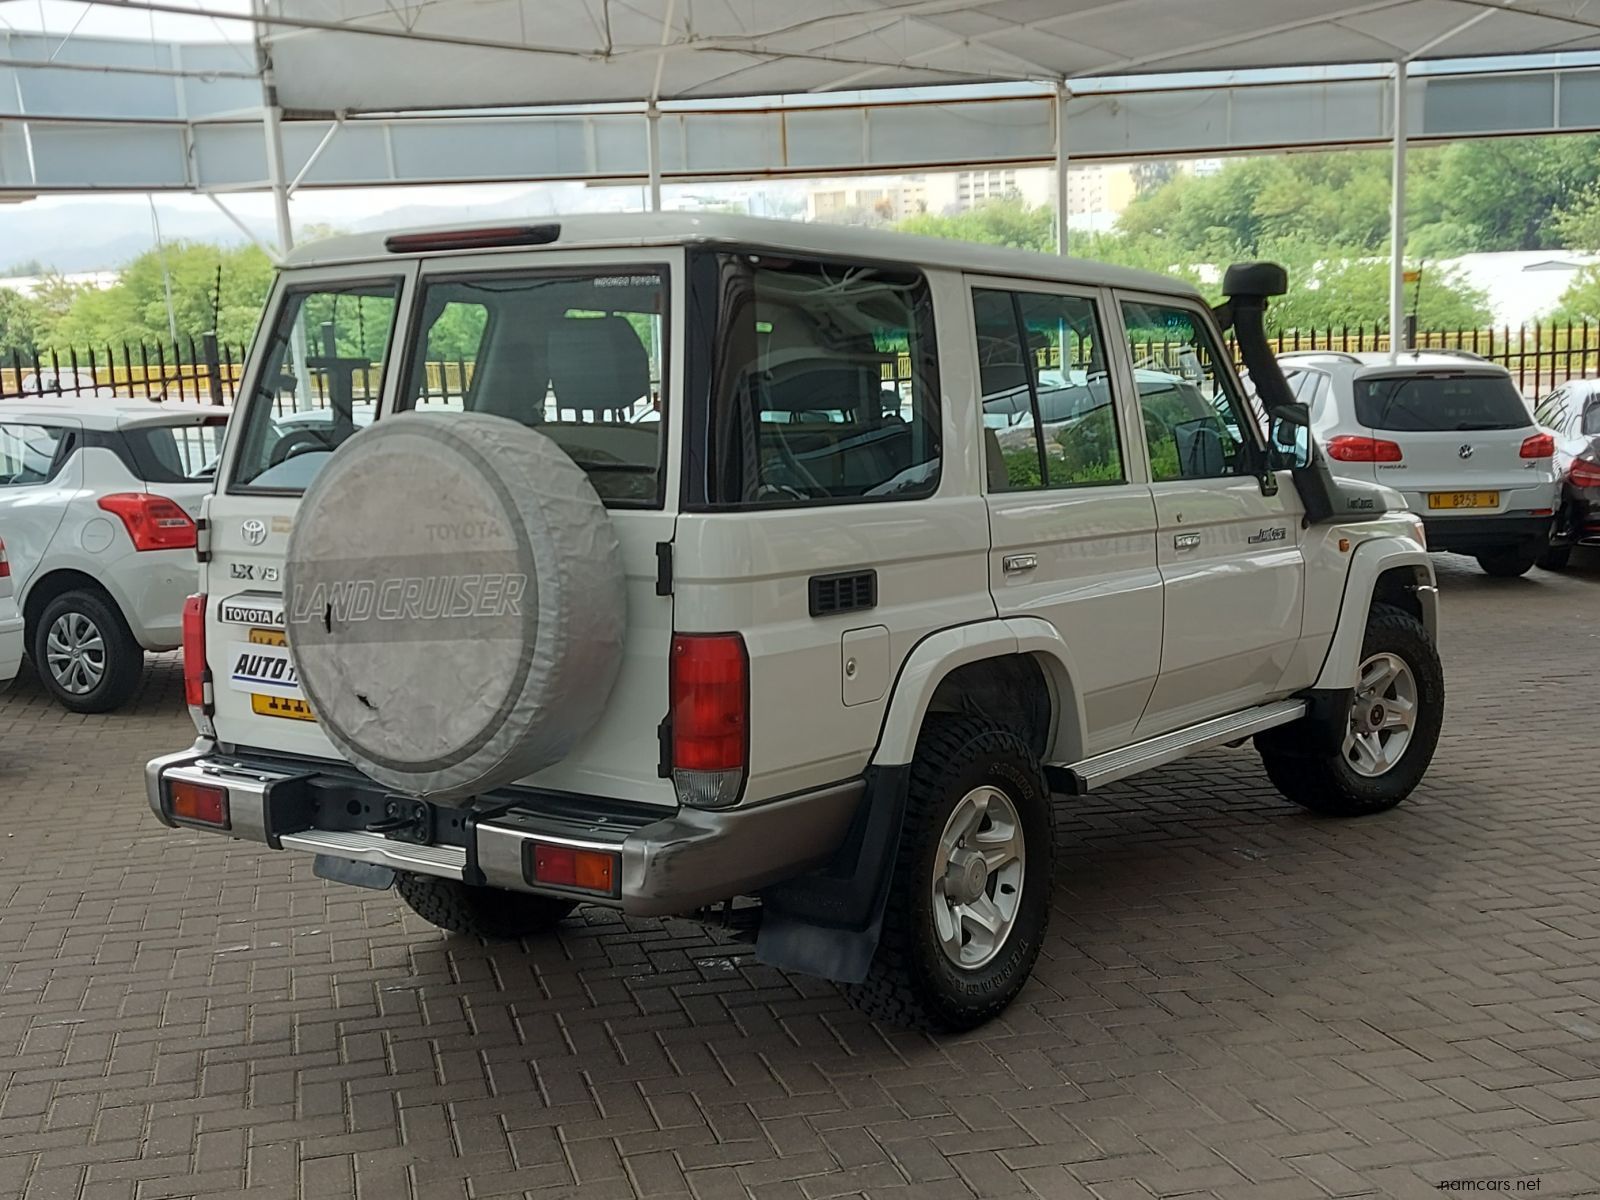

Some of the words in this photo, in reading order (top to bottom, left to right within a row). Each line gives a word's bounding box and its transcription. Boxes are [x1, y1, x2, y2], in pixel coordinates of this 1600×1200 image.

[425, 521, 502, 541] TOYOTA
[376, 573, 528, 621] CRUISER
[227, 608, 271, 624] TOYOTA
[233, 653, 288, 680] AUTO
